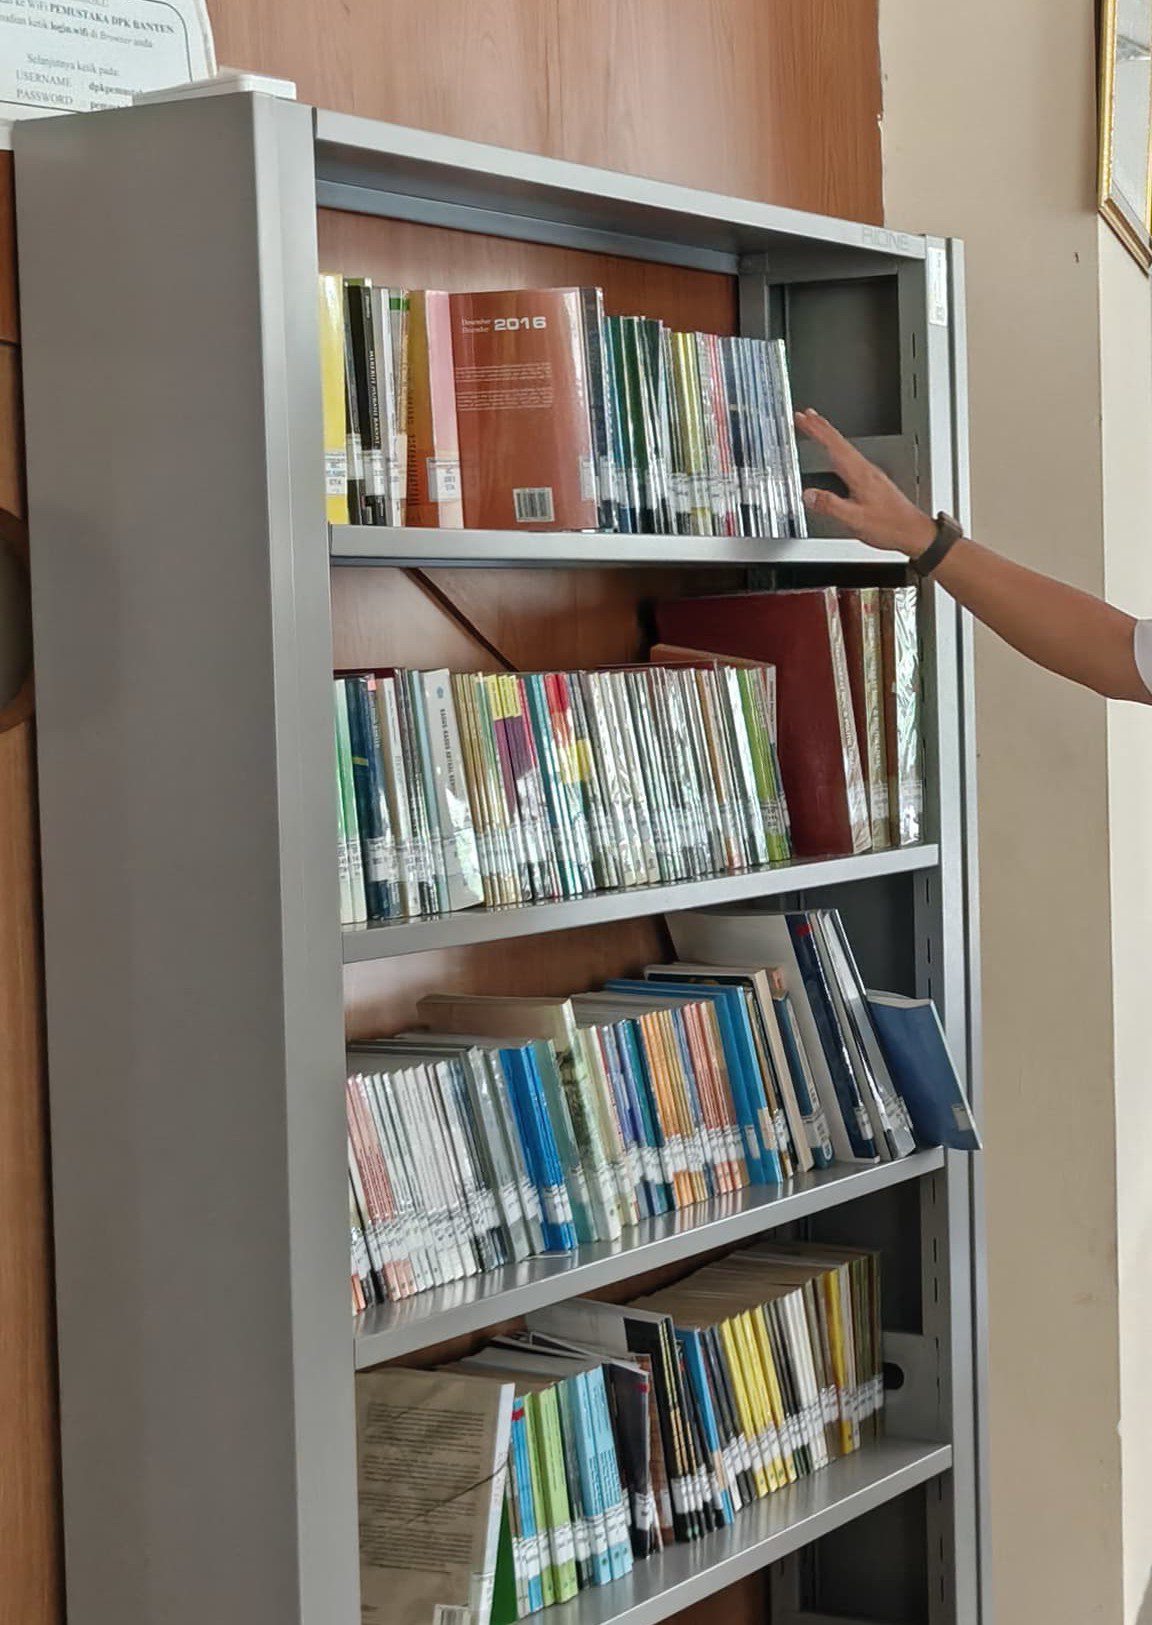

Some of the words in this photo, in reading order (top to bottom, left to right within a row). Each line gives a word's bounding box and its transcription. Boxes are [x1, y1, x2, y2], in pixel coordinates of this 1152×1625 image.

[50, 3, 109, 24] PEMUSTAKA
[111, 16, 131, 28] DPK
[133, 20, 174, 33] BANTEN
[16, 69, 72, 87] USERNAME
[16, 88, 73, 105] PASSWORD
[494, 316, 546, 331] 2016
